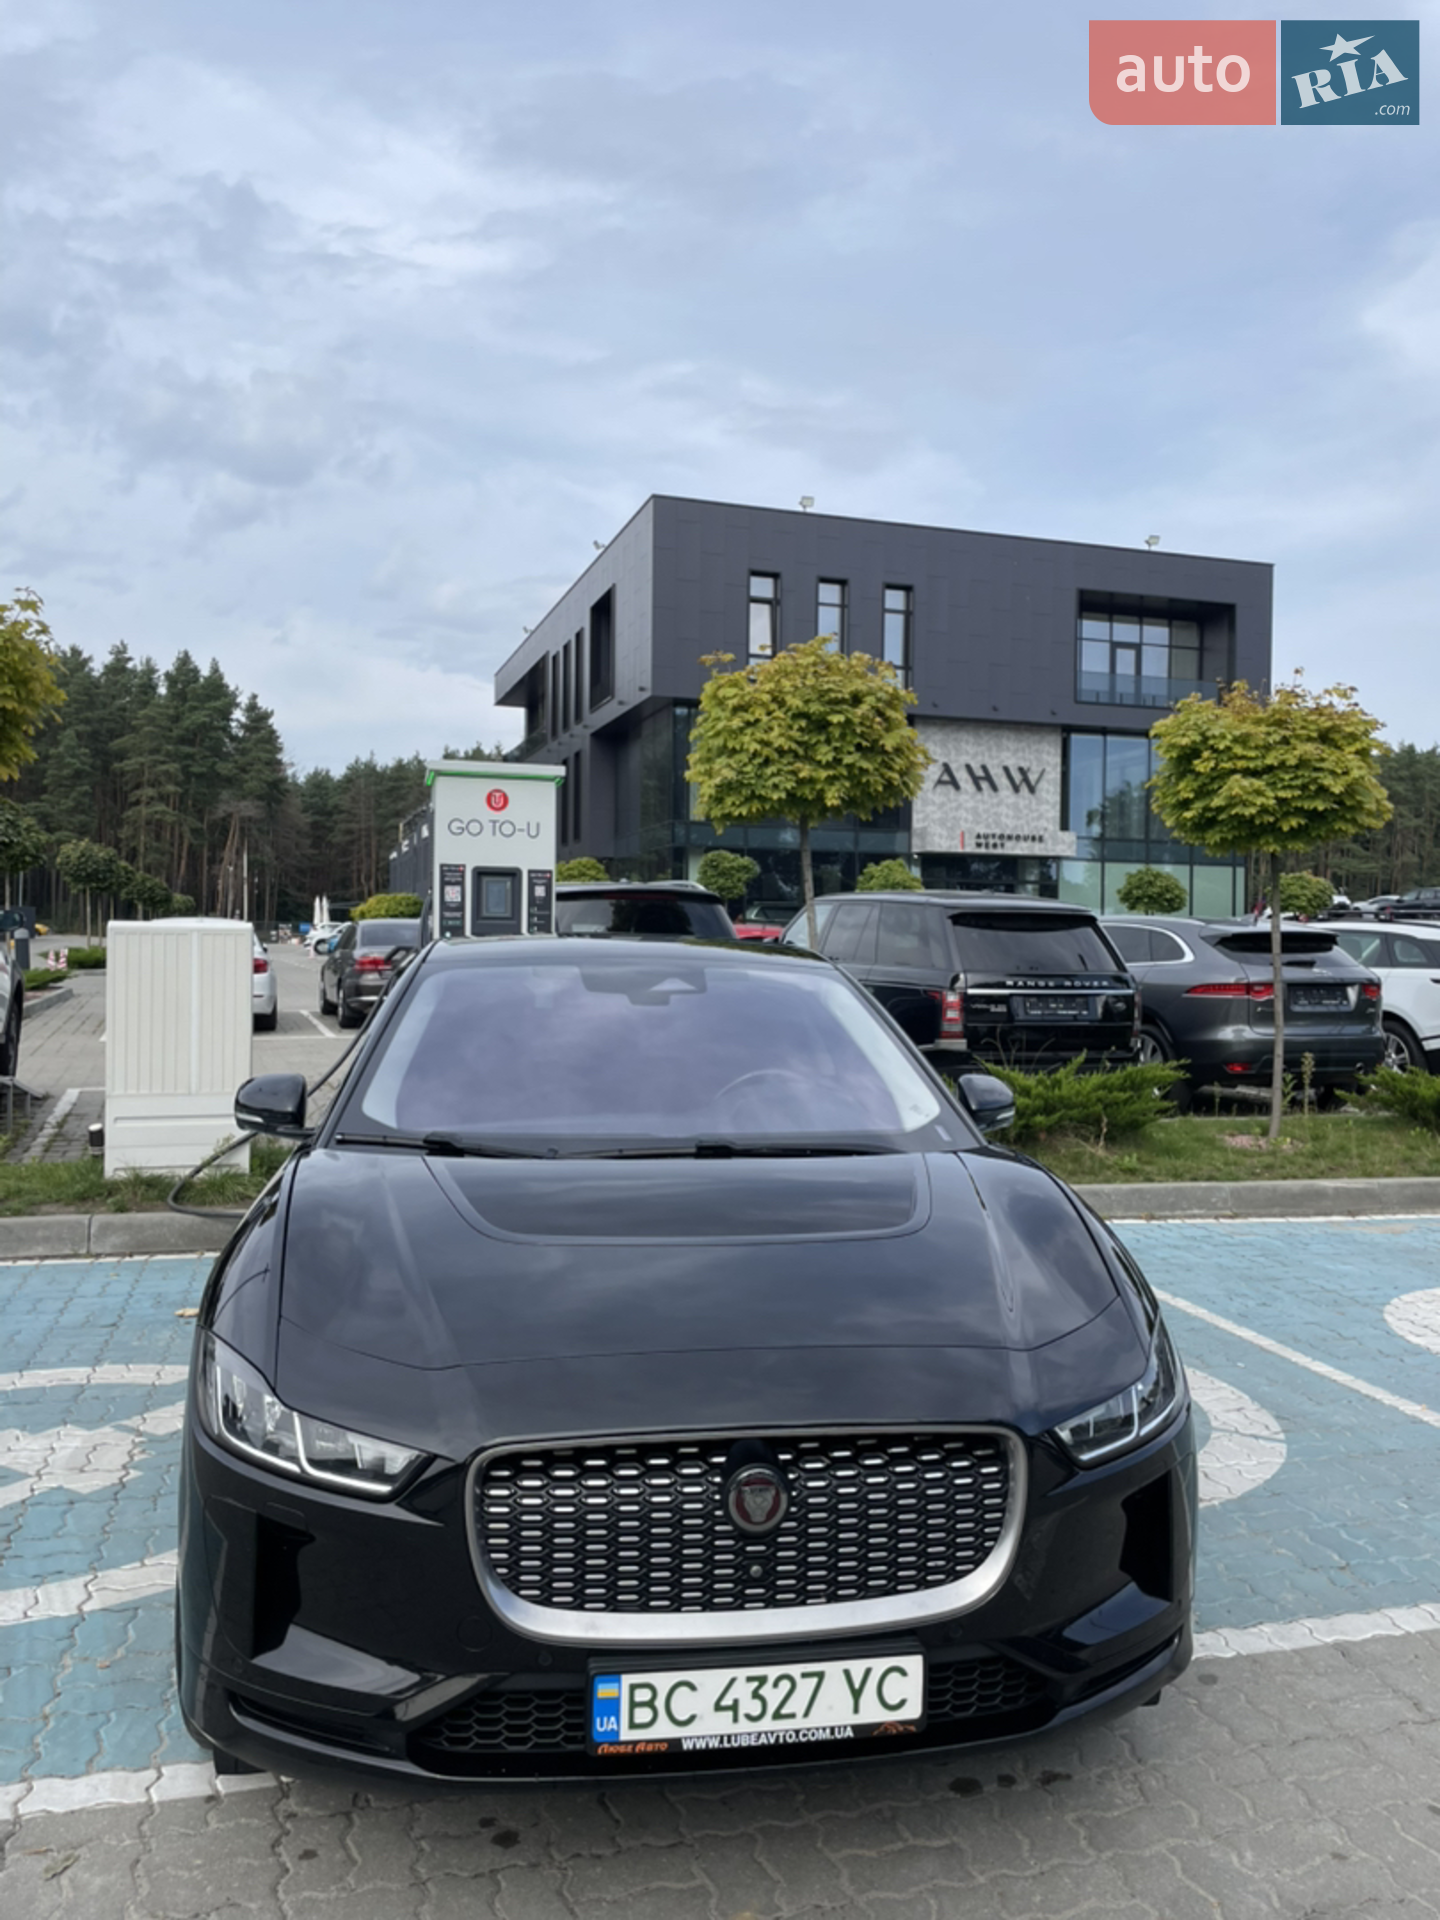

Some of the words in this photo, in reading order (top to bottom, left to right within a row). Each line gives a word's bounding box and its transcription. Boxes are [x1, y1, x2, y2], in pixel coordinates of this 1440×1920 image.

[932, 762, 1046, 795] AHW
[447, 817, 484, 837] GO
[488, 819, 541, 839] TO-U
[1006, 980, 1055, 988] RANGE
[1064, 980, 1109, 988] ROVER
[627, 1680, 698, 1730] BC
[713, 1671, 826, 1724] 4327
[842, 1665, 909, 1715] YC
[596, 1716, 619, 1732] UA
[681, 1725, 854, 1751] WWW.LUBEAVTO.COM.UA
